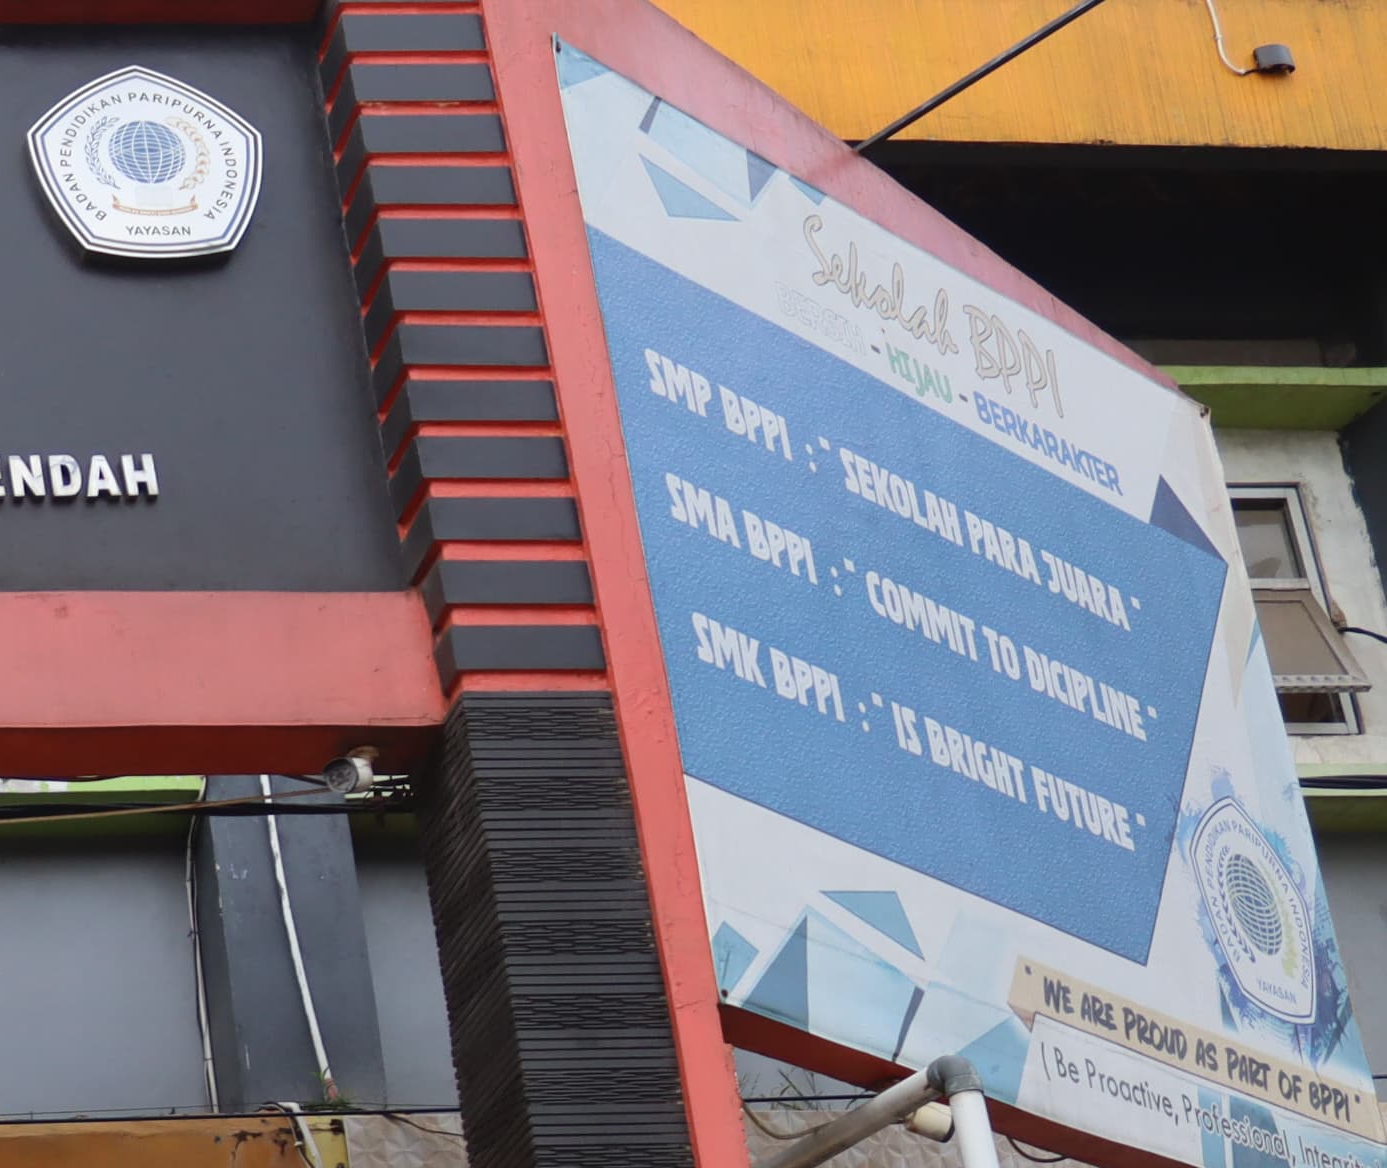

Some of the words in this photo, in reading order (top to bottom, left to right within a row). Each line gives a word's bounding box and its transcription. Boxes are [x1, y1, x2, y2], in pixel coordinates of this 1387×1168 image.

[60, 94, 122, 168] PENDIDIKAN
[128, 91, 222, 140] PARIPURNA
[204, 141, 237, 220] INDONESIA
[61, 171, 107, 222] BADAN
[126, 225, 191, 236] YAYASAN
[803, 214, 959, 355] Sekolah
[963, 304, 1064, 418] BPPI
[644, 348, 712, 419] SMP
[719, 384, 794, 461] BPPI
[840, 447, 964, 546] SEKOLAH
[964, 510, 1041, 585] PARA
[886, 342, 953, 404] HIJAU
[973, 390, 1123, 497] BERKARAKTER
[664, 472, 741, 549] SMA
[742, 510, 818, 586] BPPI
[865, 571, 979, 662] COMMIT
[982, 624, 1021, 681] TO
[691, 612, 767, 689] SMK
[769, 647, 846, 722] BPPI
[890, 701, 922, 756] IS
[924, 716, 1027, 804] BRIGHT
[1043, 976, 1075, 1014] WE
[1081, 992, 1117, 1031] ARE
[1123, 1007, 1187, 1060] PROUD
[1195, 1037, 1218, 1072] AS
[1226, 1047, 1269, 1093] PART
[1279, 1070, 1301, 1100] OF
[1309, 1079, 1351, 1122] BPPI
[1054, 1047, 1079, 1083] Be
[1086, 1062, 1179, 1126] Proactive,
[1182, 1094, 1296, 1167] Professional,
